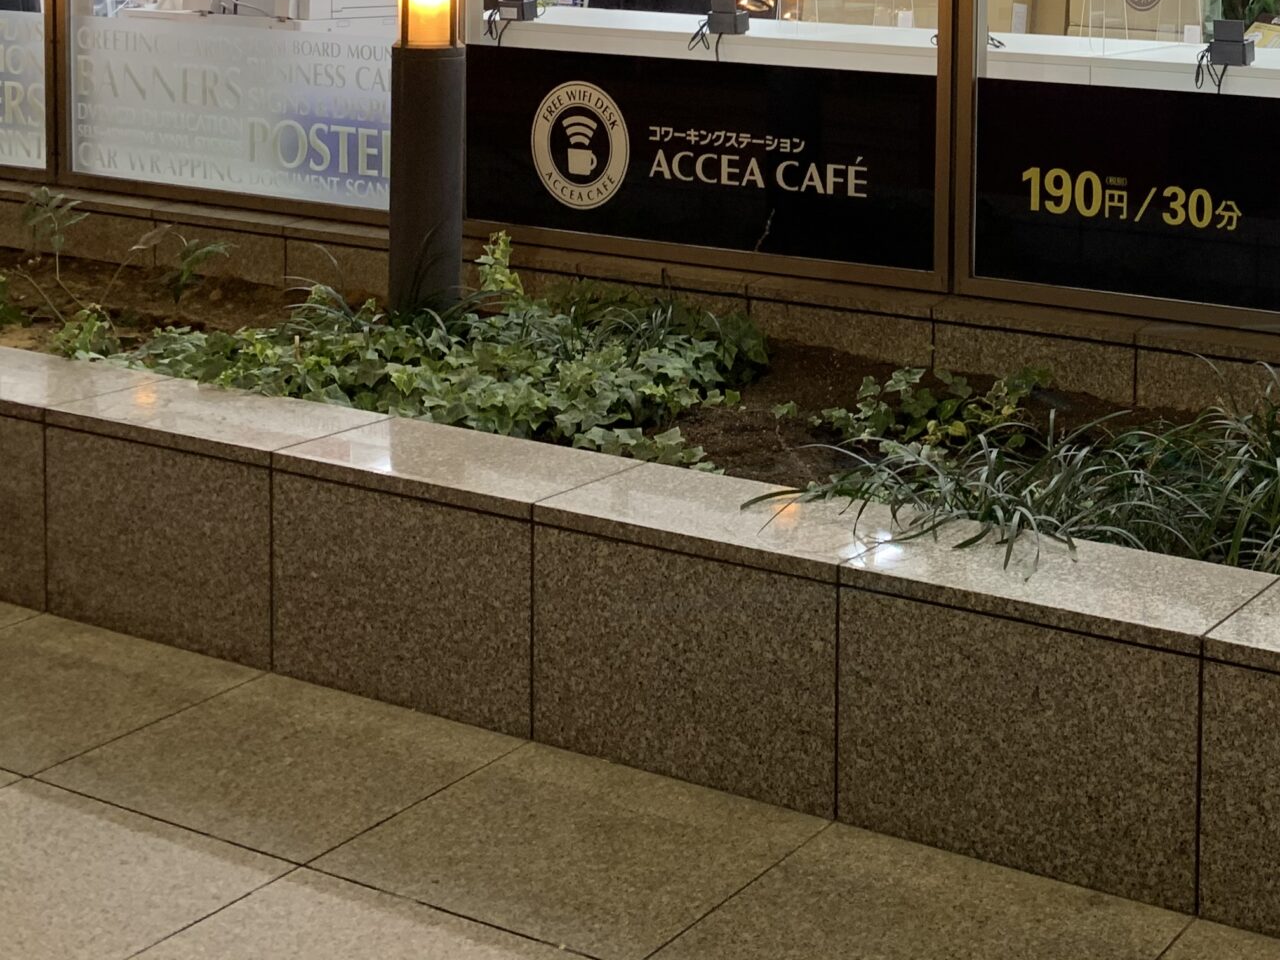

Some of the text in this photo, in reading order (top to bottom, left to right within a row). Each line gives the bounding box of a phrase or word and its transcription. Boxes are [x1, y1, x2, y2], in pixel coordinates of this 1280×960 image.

[292, 40, 342, 58] BOARD
[76, 54, 244, 110] BANNERS
[542, 89, 620, 131] FREE WIFI DESK
[649, 126, 805, 152] コワーキングステーション
[545, 171, 584, 201] ACCEA
[649, 148, 868, 198] ACCEA CAFÉ
